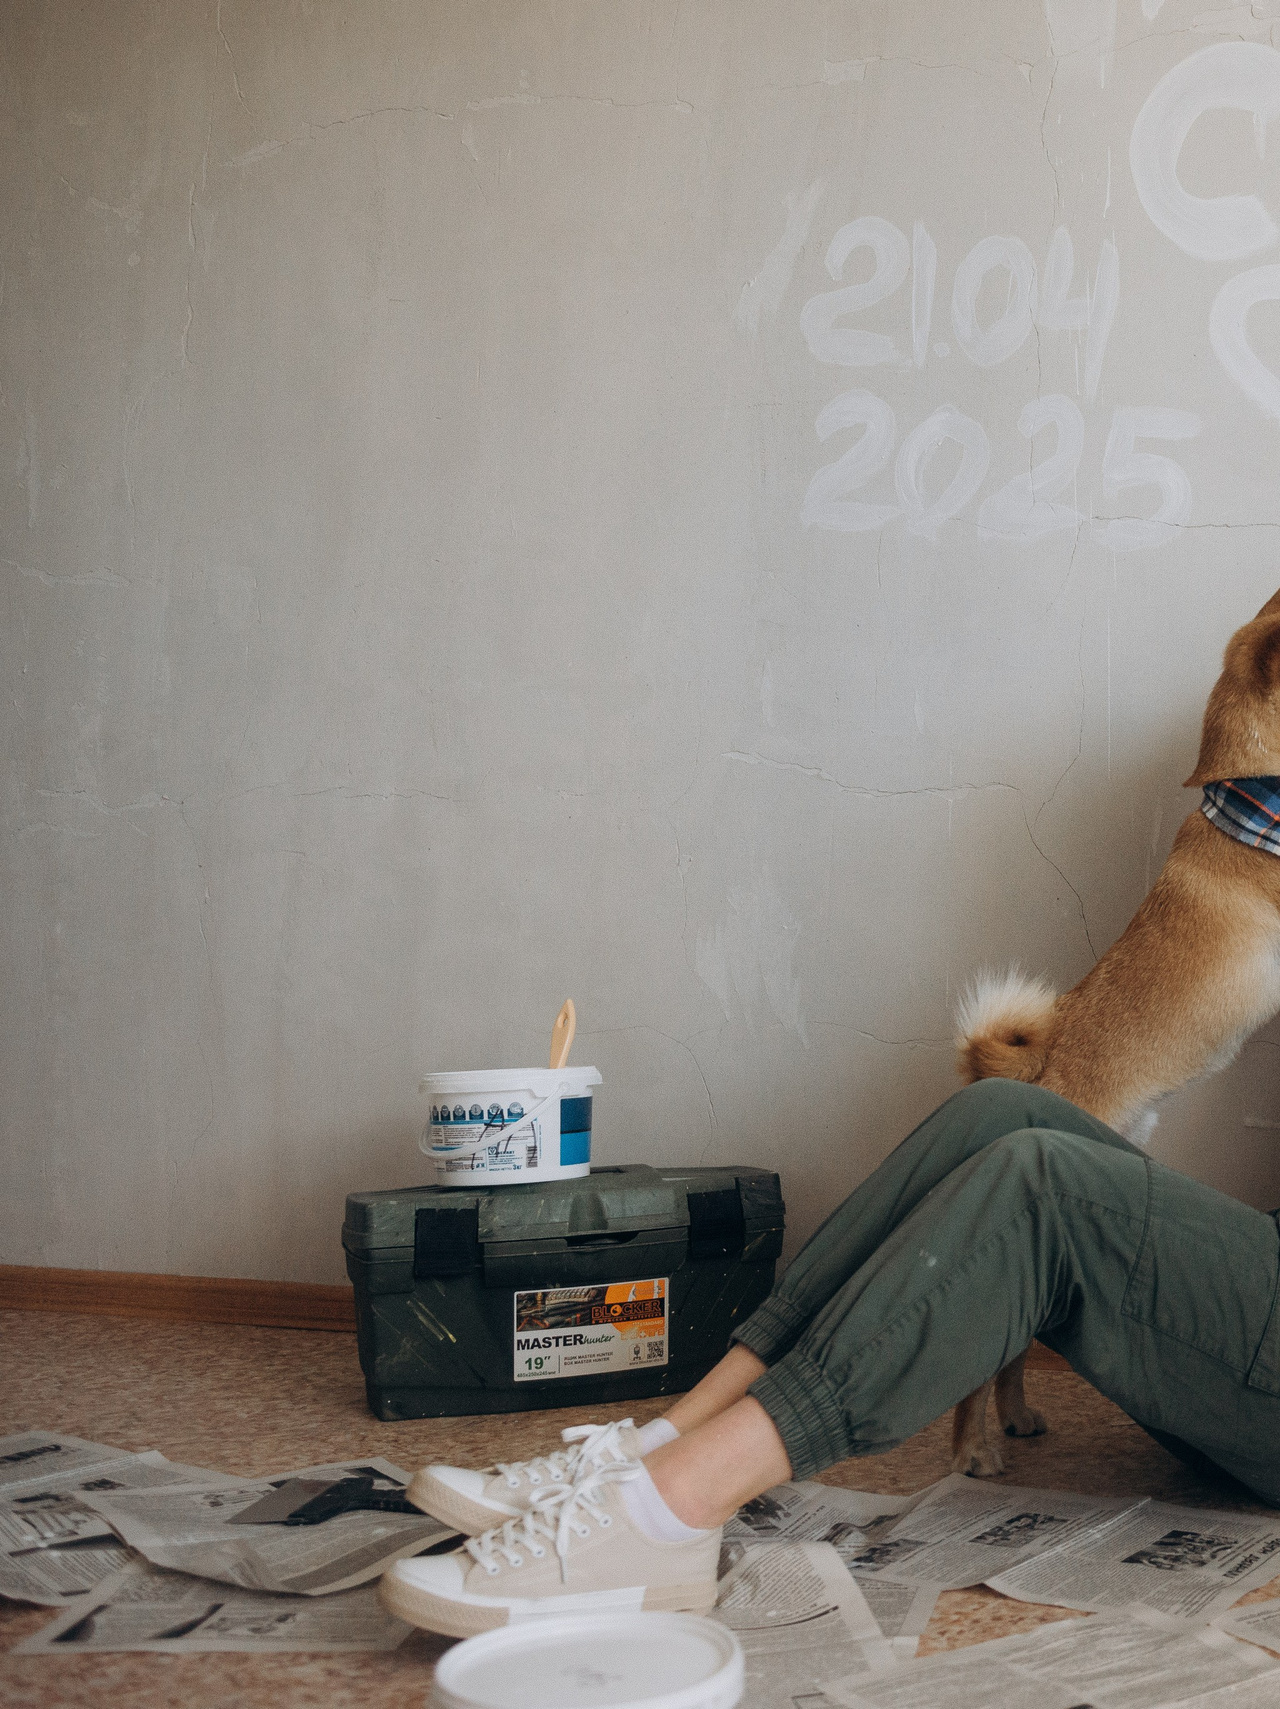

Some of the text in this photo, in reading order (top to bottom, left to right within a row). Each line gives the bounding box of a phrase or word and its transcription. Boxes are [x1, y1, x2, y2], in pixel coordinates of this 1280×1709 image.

[801, 214, 1120, 400] 21.04
[803, 387, 1201, 552] 2025
[591, 1299, 662, 1319] BLOCKER
[574, 1358, 592, 1366] MASTER
